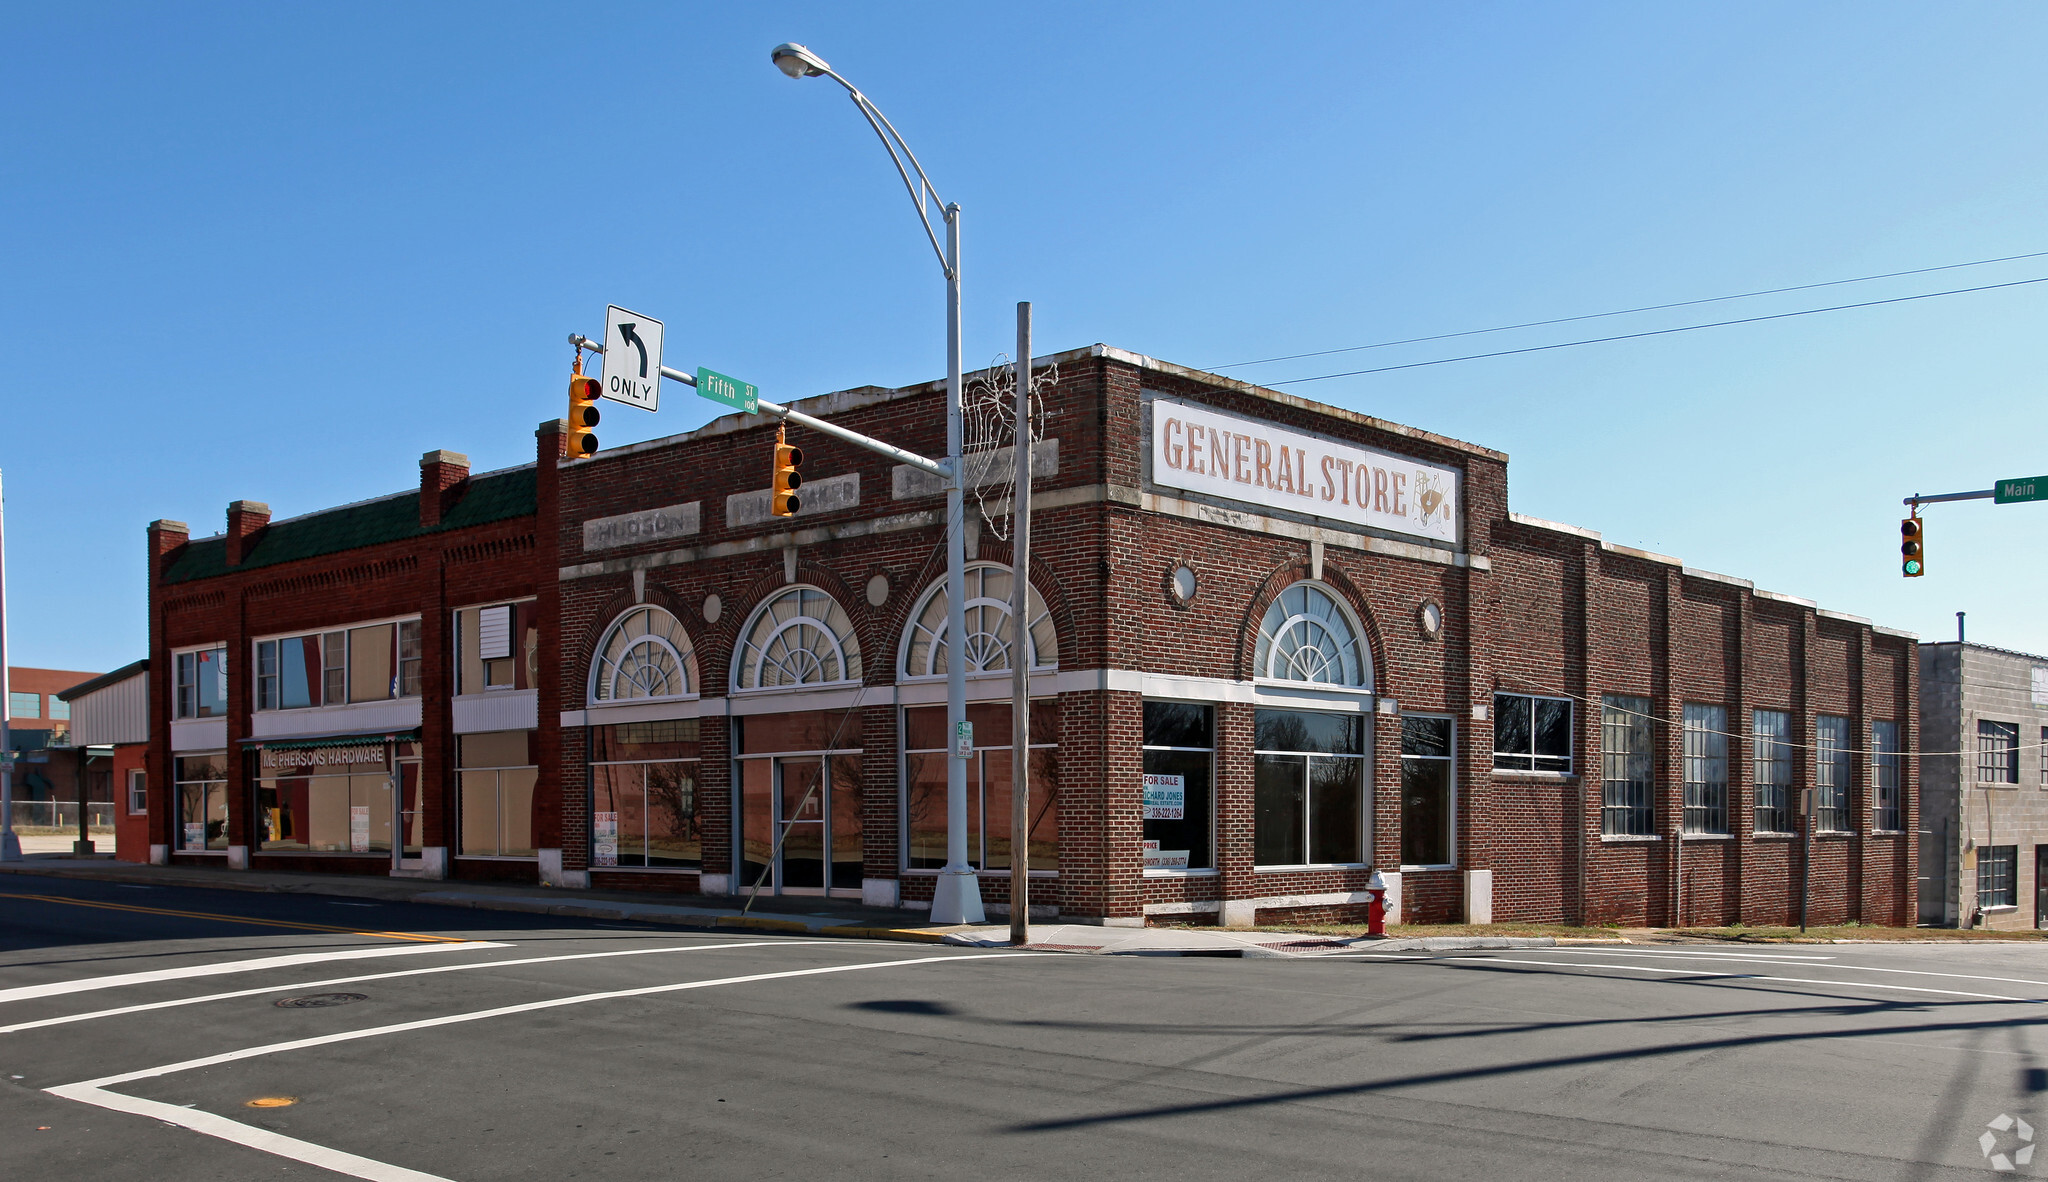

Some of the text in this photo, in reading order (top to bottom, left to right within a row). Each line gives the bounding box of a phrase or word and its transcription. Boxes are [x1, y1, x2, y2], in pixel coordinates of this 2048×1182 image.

[610, 375, 652, 402] ONLY
[707, 375, 754, 400] Fifth ST
[744, 399, 755, 411] 100
[1163, 416, 1408, 517] GENERAL STORE
[2004, 481, 2035, 497] Main
[597, 511, 684, 542] HUDSON
[263, 747, 384, 768] Mc PHERSONS HARDWARE
[1144, 775, 1179, 786] FOR SALE
[1166, 791, 1183, 801] JONES
[594, 813, 617, 822] FOR SALE
